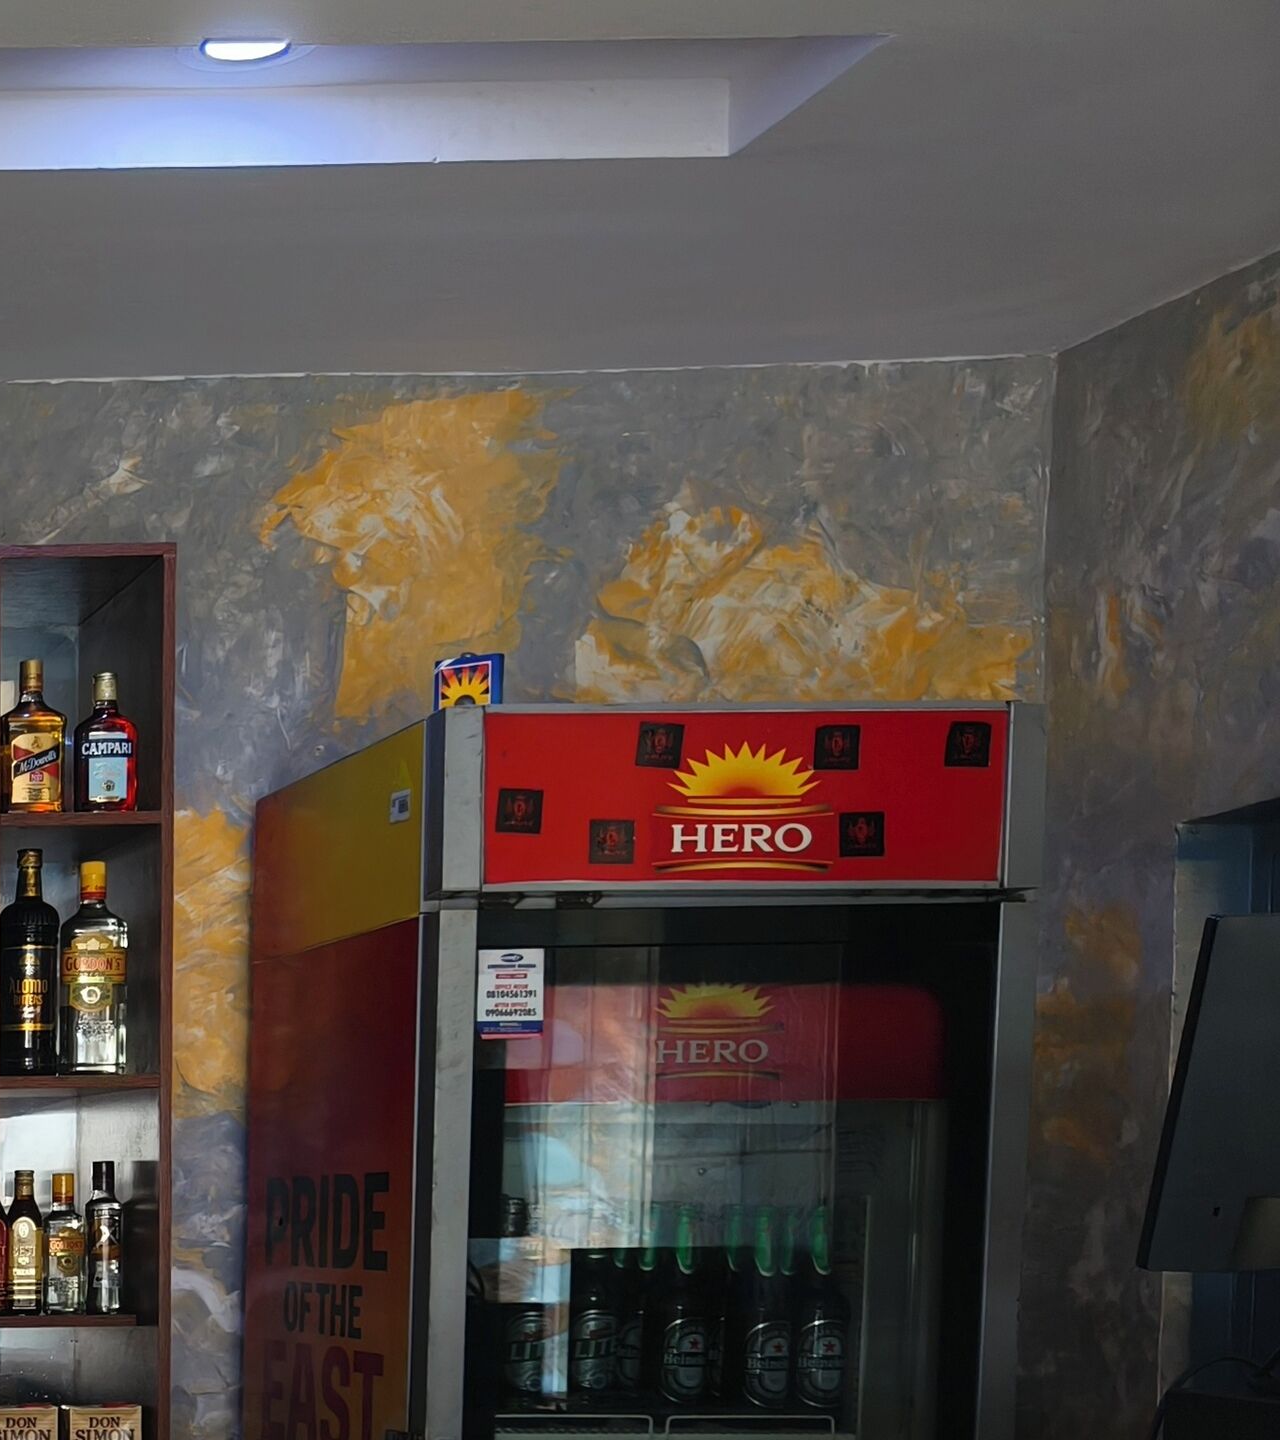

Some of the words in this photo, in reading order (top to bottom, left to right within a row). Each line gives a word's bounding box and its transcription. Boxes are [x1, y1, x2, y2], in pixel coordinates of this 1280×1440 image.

[82, 742, 132, 755] CAMPARI
[671, 823, 813, 854] HERO
[65, 957, 121, 971] GORDON'S
[656, 1039, 768, 1063] HERO
[265, 1172, 389, 1271] PRIDE
[283, 1281, 313, 1334] OF
[314, 1283, 362, 1339] THE
[6, 1417, 37, 1428] DON
[89, 1417, 121, 1428] DON
